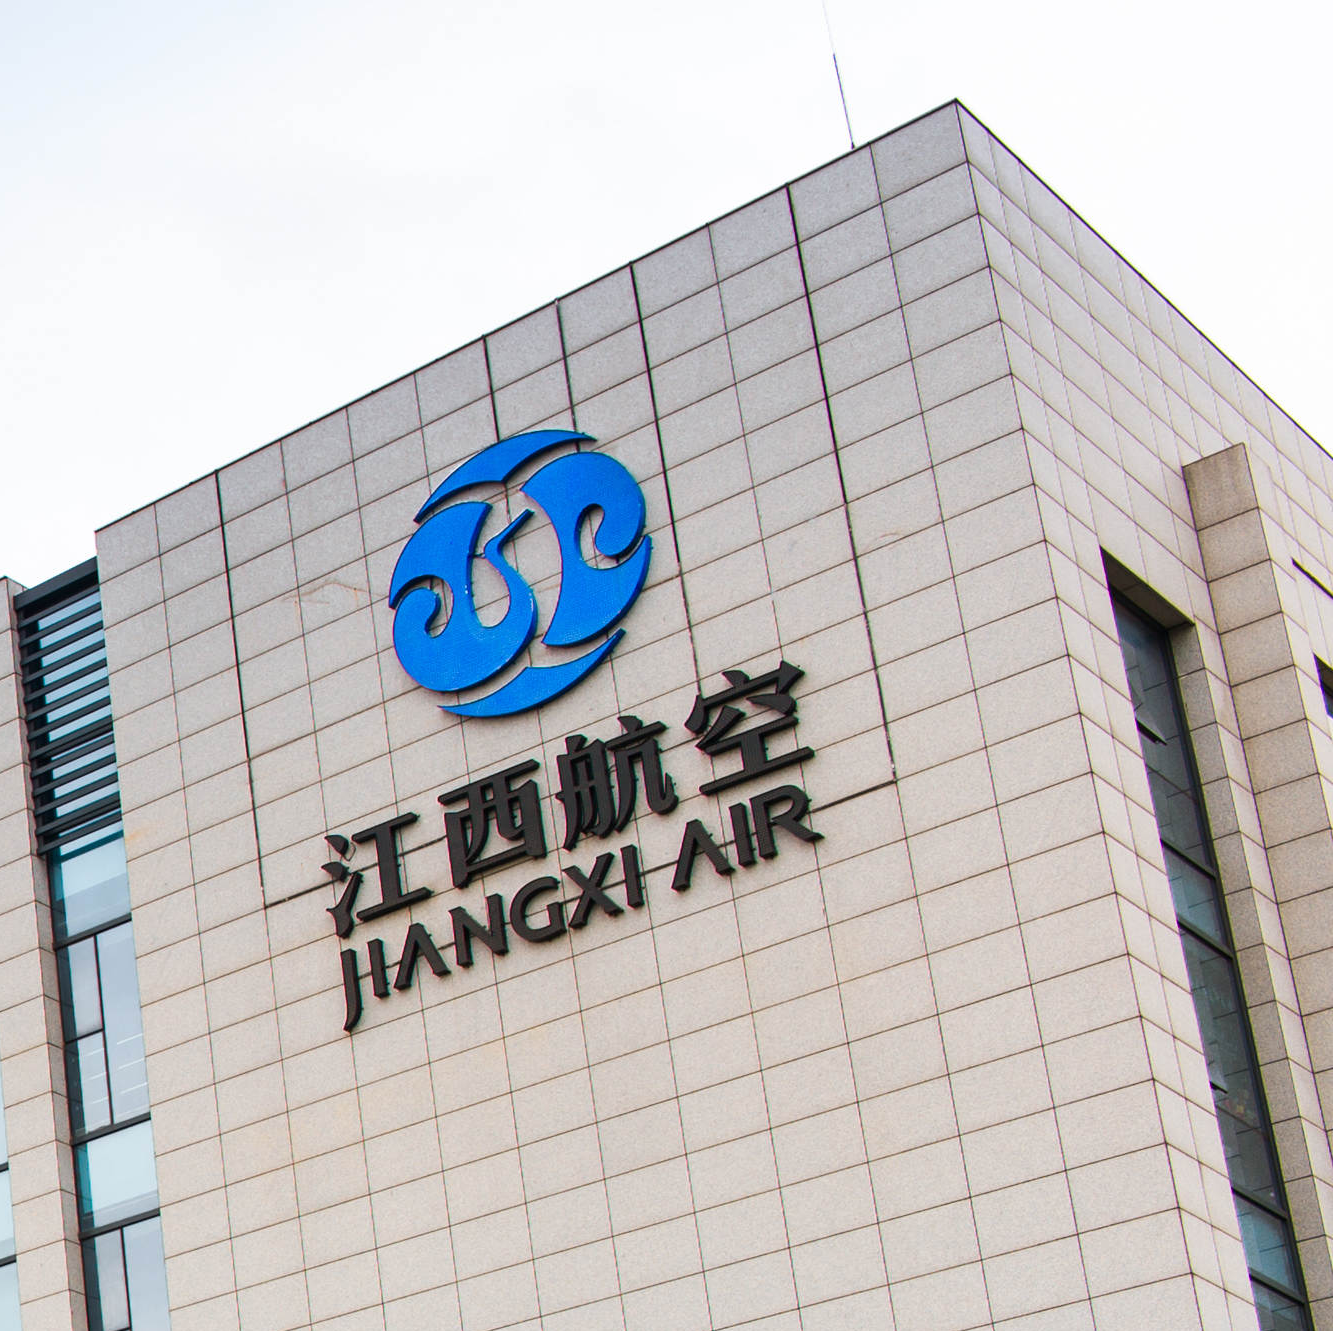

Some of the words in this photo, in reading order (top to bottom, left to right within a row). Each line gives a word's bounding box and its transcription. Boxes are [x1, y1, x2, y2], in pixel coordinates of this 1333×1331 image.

[321, 660, 816, 939] 江西航空
[340, 844, 645, 1033] JIANGXI
[671, 784, 824, 892] AIR
